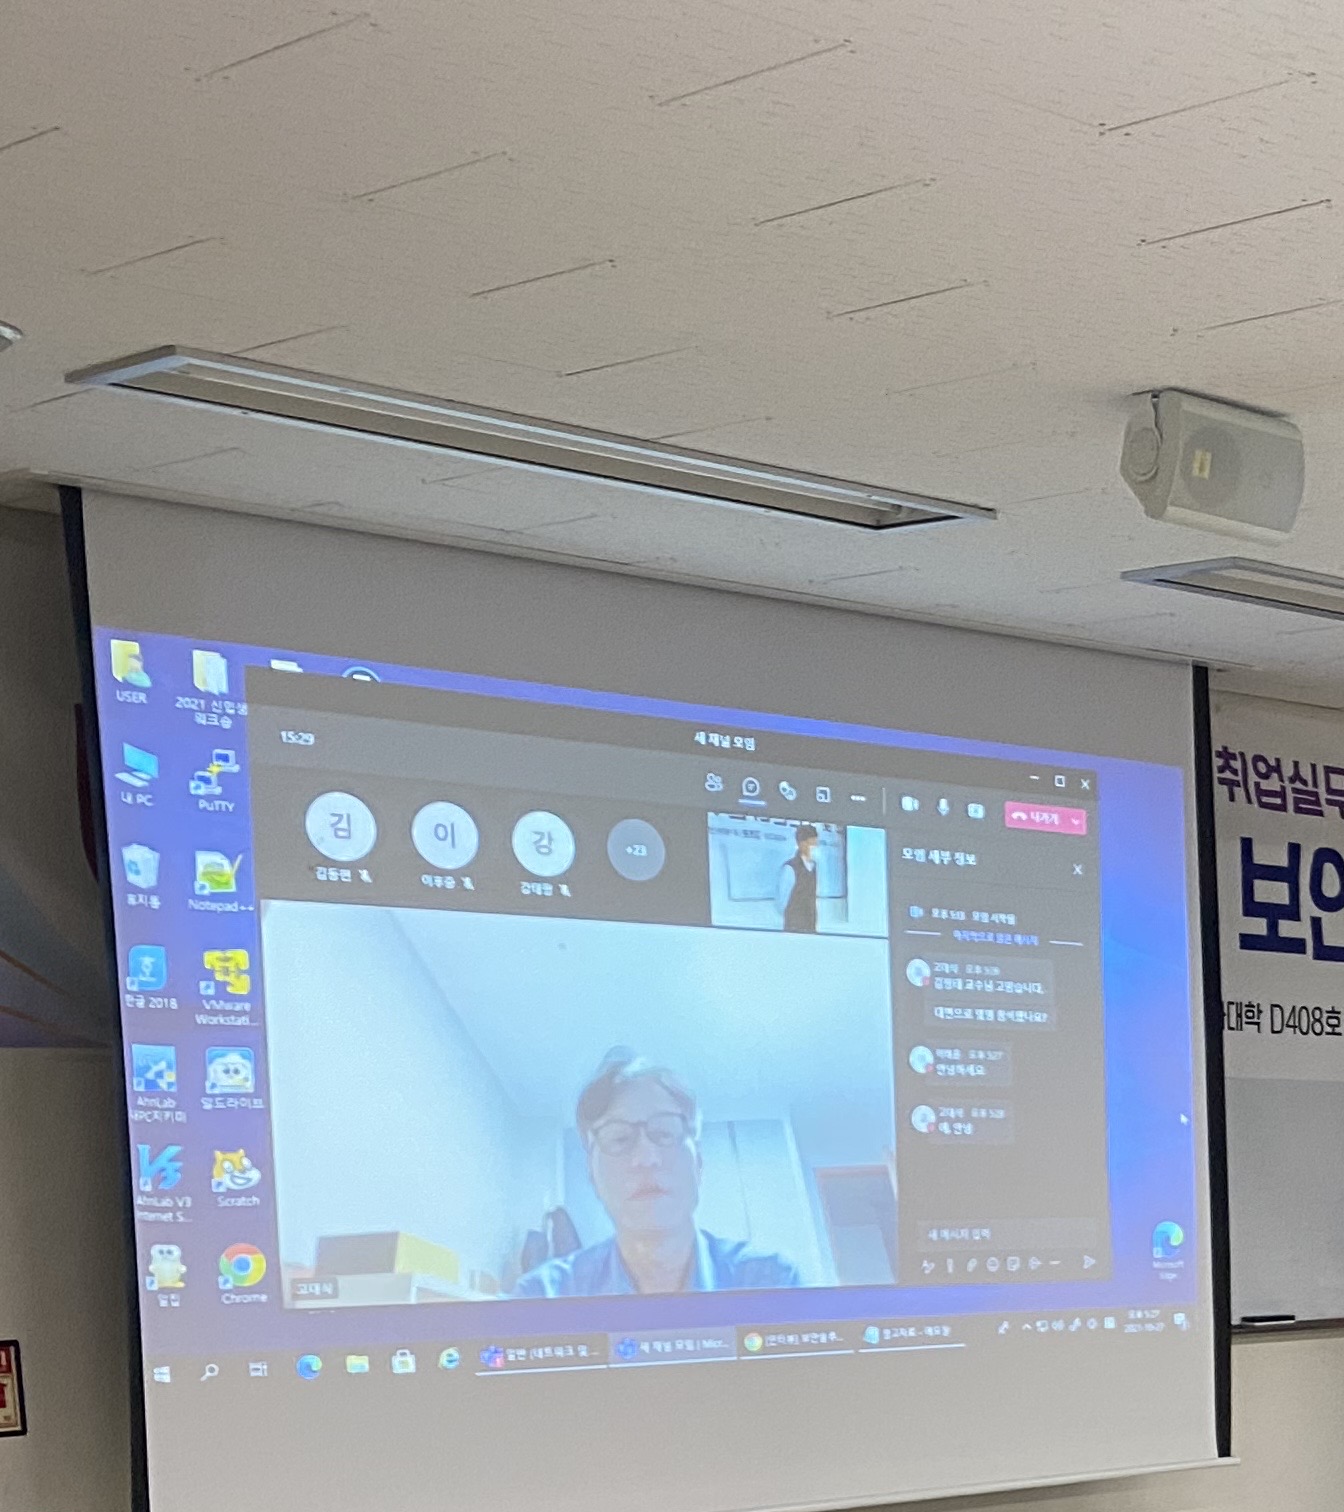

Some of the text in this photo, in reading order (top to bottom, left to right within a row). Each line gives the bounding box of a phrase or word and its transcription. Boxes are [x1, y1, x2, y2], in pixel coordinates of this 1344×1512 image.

[116, 690, 147, 703] USER
[175, 696, 205, 711] 2021
[136, 793, 154, 806] PC
[330, 812, 353, 840] 김
[433, 822, 456, 849] 이
[531, 830, 554, 856] 강
[187, 898, 254, 913] Notepad++
[202, 999, 251, 1012] VMware
[1222, 1000, 1343, 1036] 대학 D408호
[217, 1195, 260, 1208] Scratch
[220, 1292, 268, 1305] Chrome
